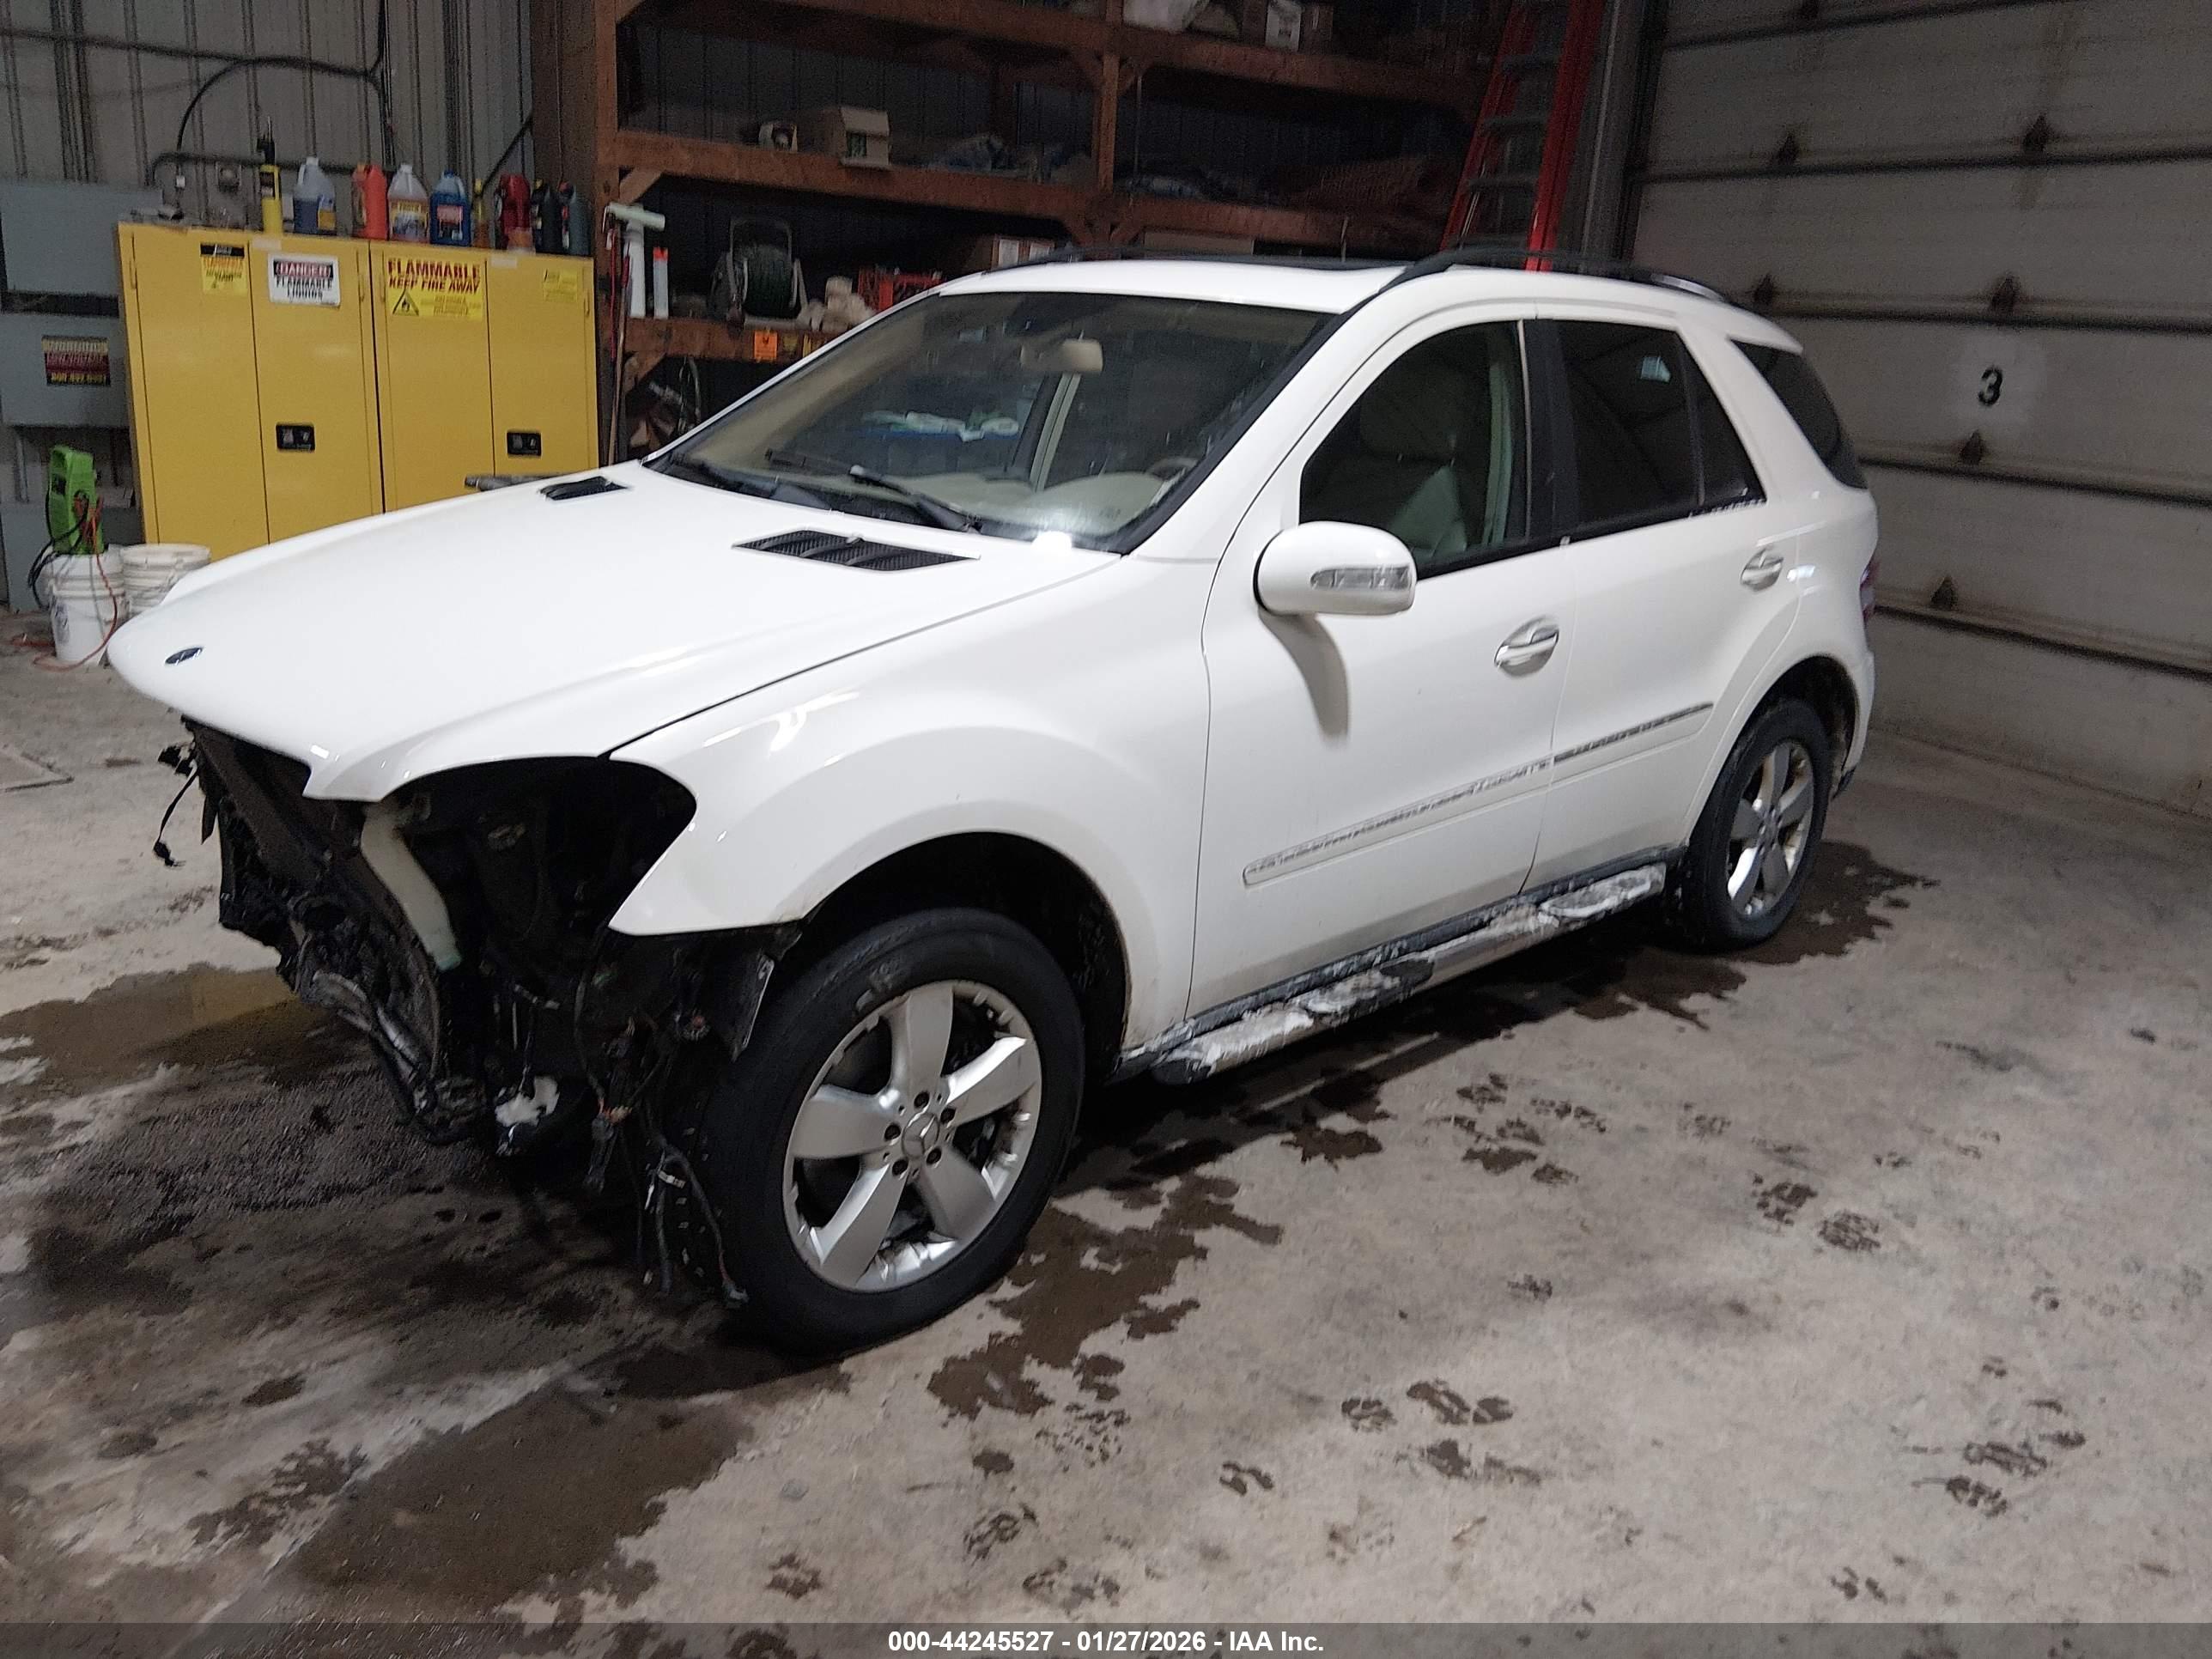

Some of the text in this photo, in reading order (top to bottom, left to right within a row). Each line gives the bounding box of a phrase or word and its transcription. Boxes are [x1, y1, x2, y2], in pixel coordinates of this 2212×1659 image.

[276, 261, 331, 276] DANGER
[387, 258, 481, 279] FLAMMABLE
[276, 276, 333, 289] FLAMMABLE
[389, 276, 480, 294] KEEP FIRE AWAY
[1977, 366, 2003, 407] 3
